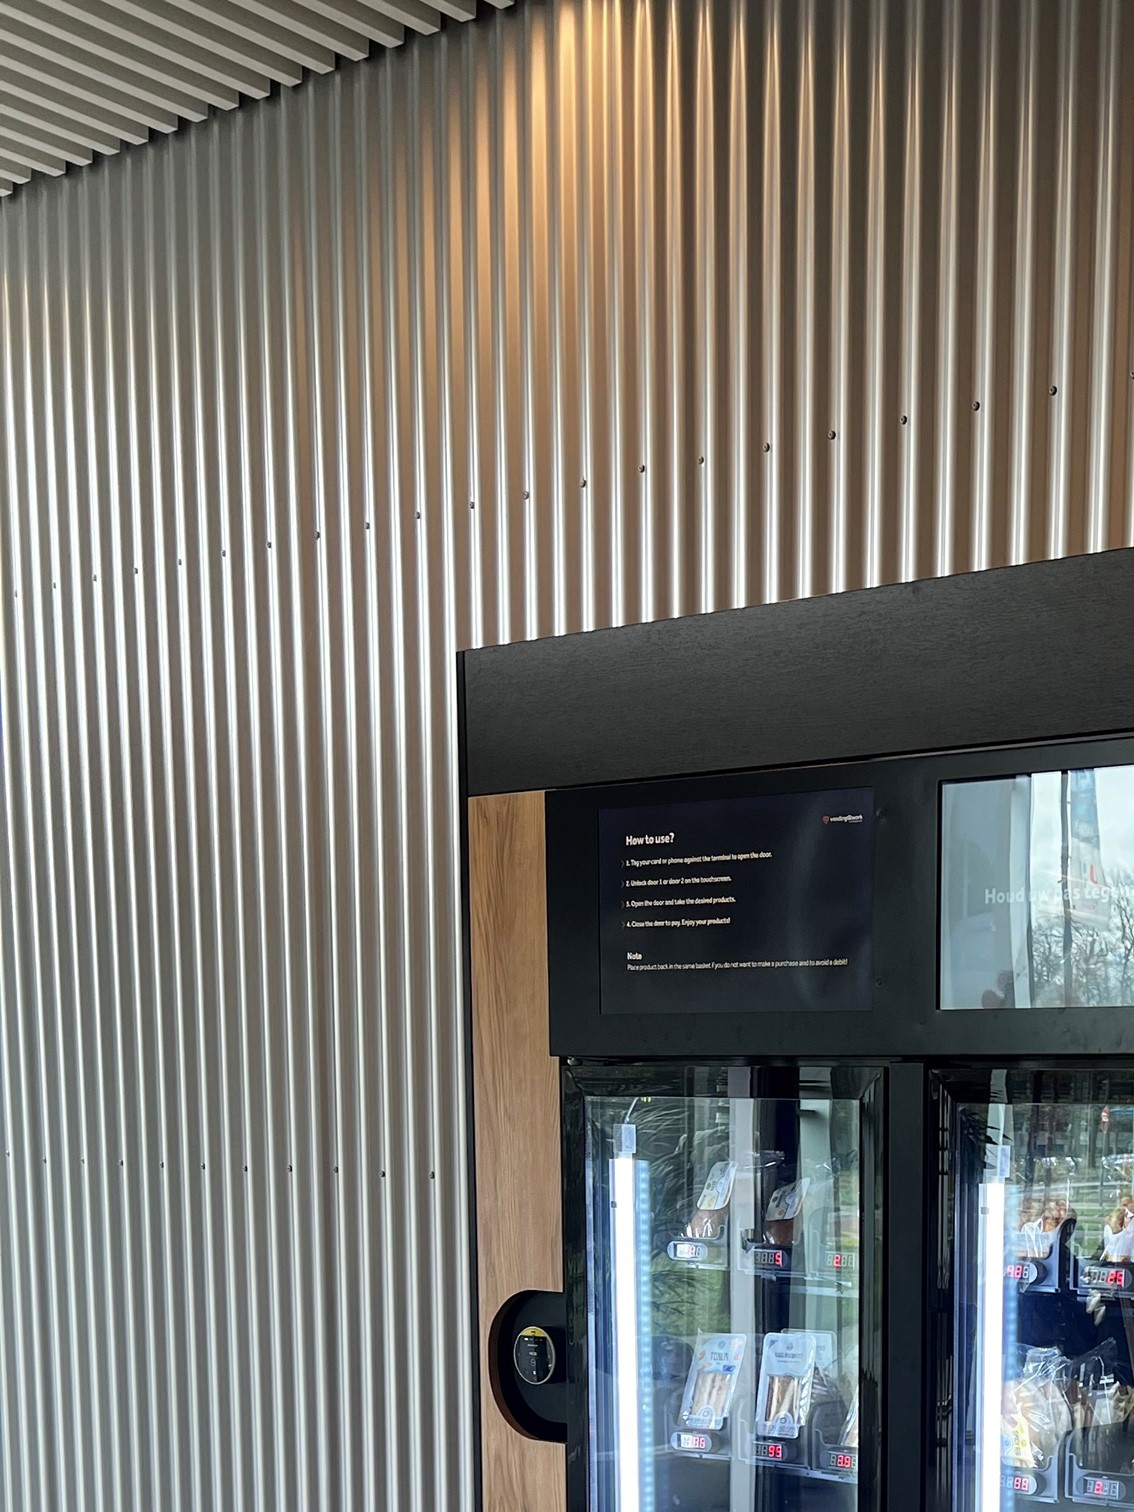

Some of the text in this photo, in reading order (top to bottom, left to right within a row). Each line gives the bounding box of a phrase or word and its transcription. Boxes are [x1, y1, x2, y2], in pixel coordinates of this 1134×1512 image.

[626, 832, 675, 846] How to use?
[630, 858, 640, 868] Tag
[640, 859, 650, 867] your
[668, 856, 684, 866] phone
[684, 856, 702, 864] against
[710, 854, 731, 862] terminal
[984, 886, 1026, 904] Houd
[630, 900, 644, 908] Open
[694, 896, 712, 904] desired
[712, 896, 736, 904] products.
[682, 918, 695, 926] Enjoy
[707, 916, 730, 926] products!
[626, 952, 642, 960] Note
